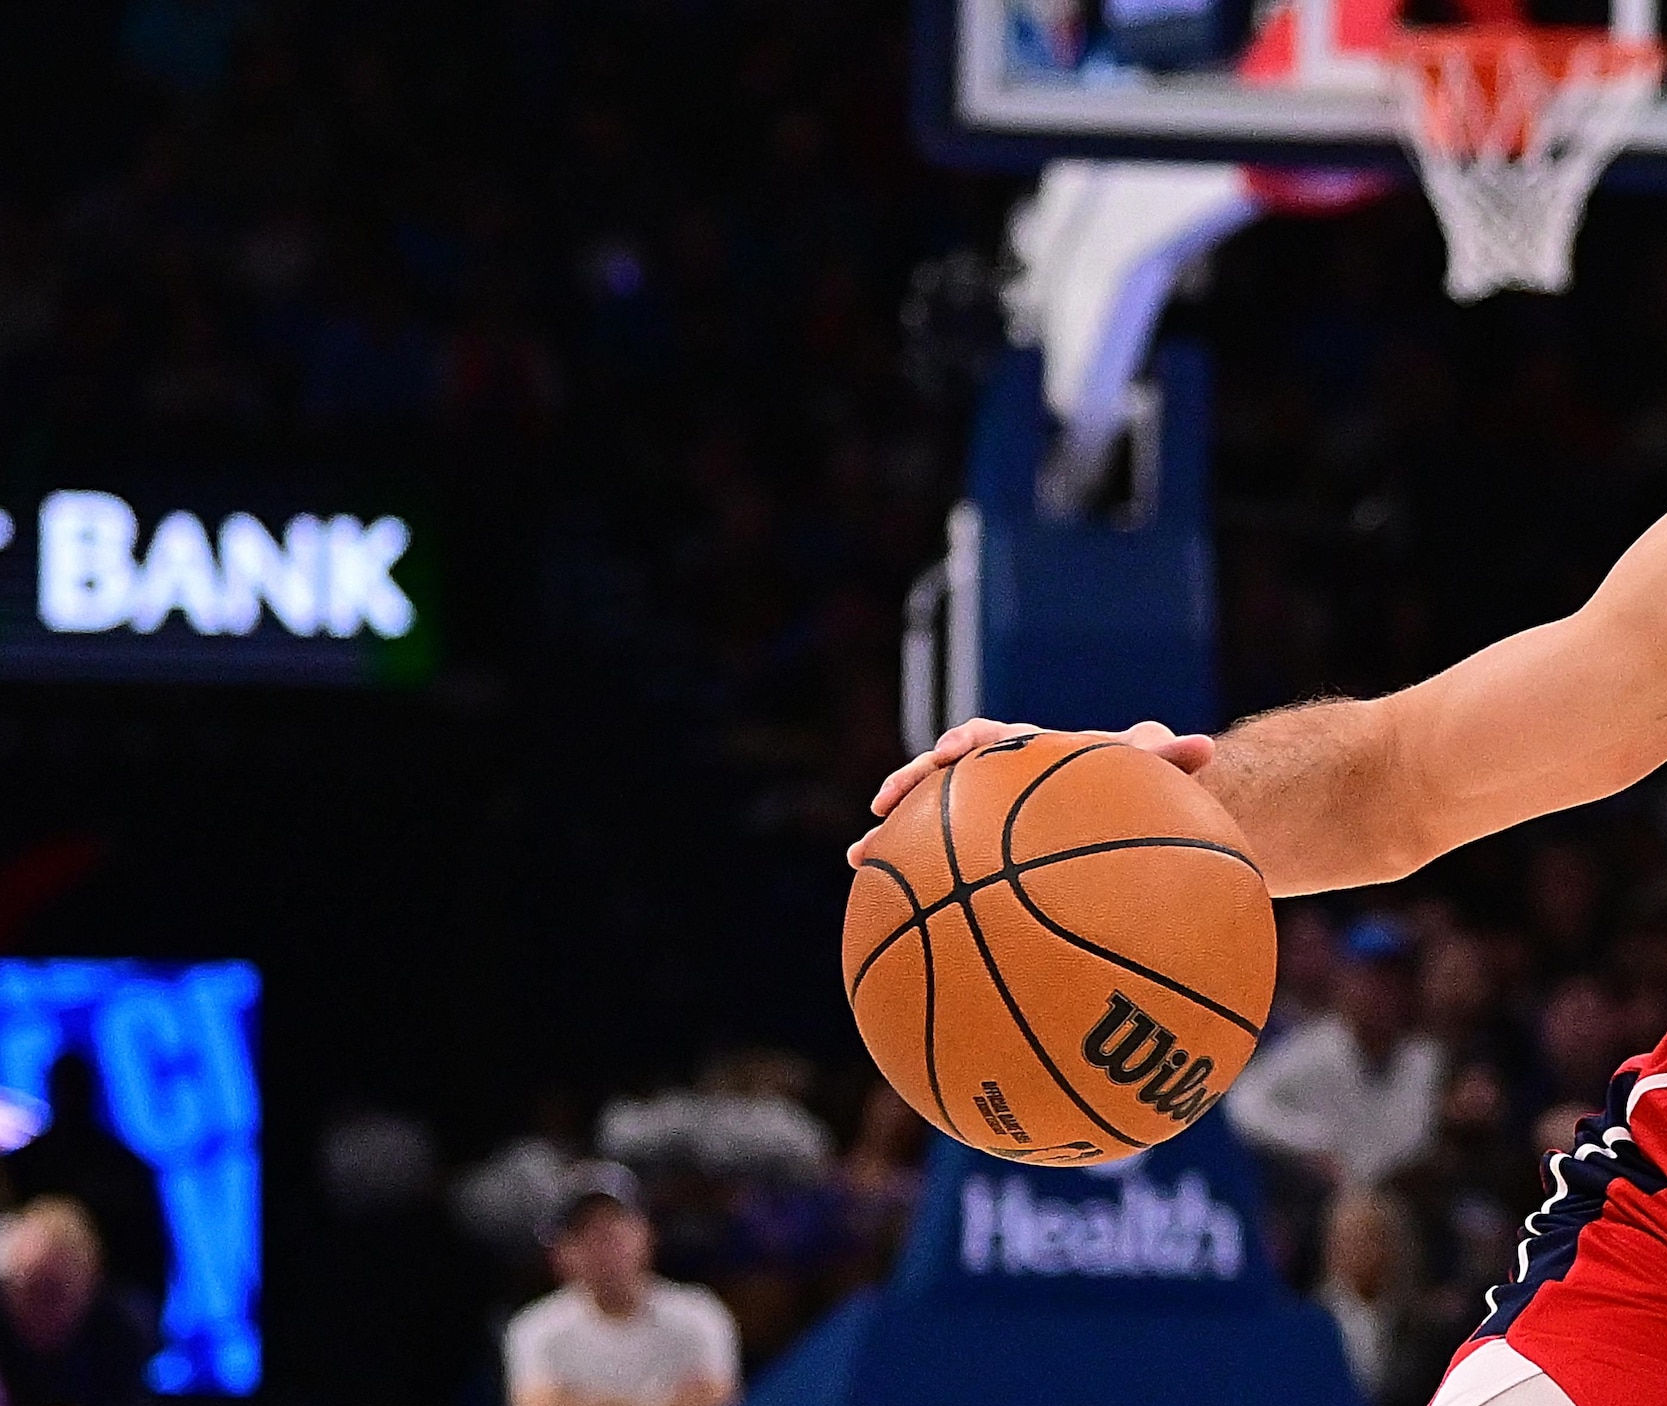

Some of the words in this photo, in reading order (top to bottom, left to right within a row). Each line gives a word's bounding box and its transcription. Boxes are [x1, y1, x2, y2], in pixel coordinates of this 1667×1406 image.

[38, 489, 416, 638] BANK
[1081, 989, 1223, 1125] Wils
[962, 1174, 1245, 1280] Health
